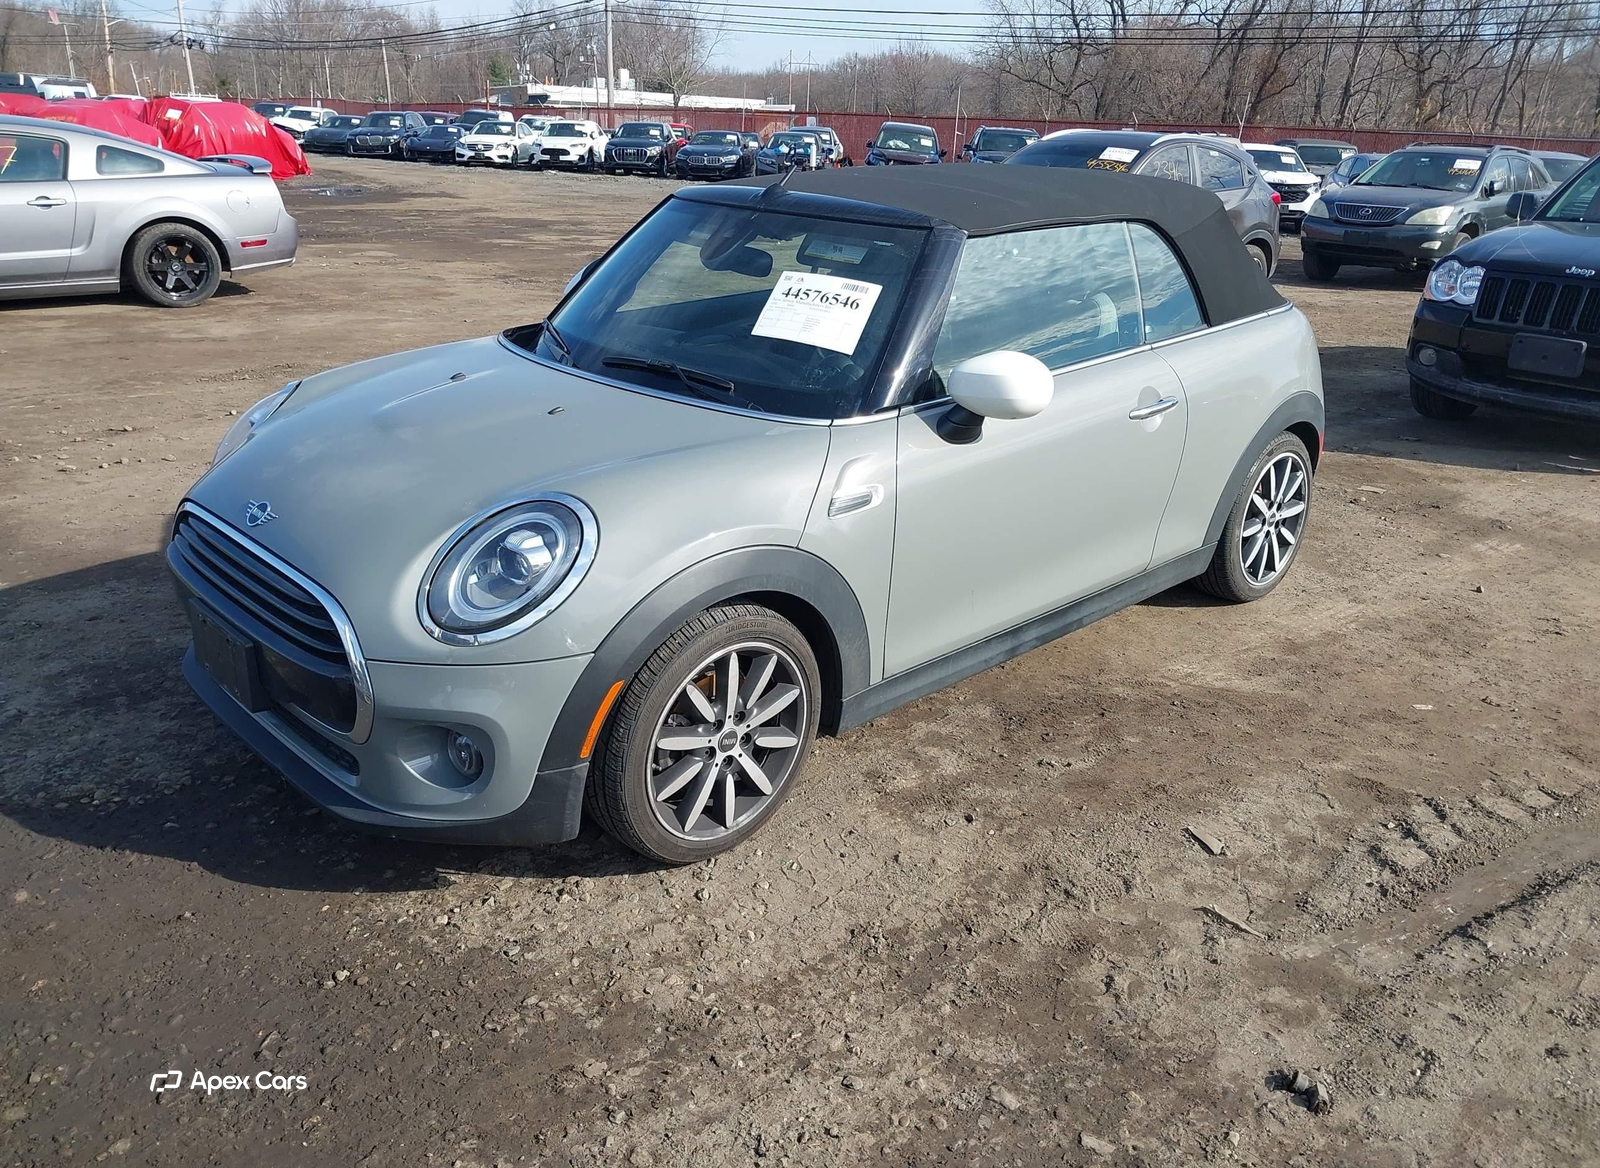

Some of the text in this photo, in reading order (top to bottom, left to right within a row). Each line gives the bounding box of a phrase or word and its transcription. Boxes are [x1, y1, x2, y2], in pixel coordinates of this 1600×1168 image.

[1565, 265, 1595, 277] Jeep
[781, 286, 862, 310] 44576546
[725, 621, 769, 634] BRIDGESTONE
